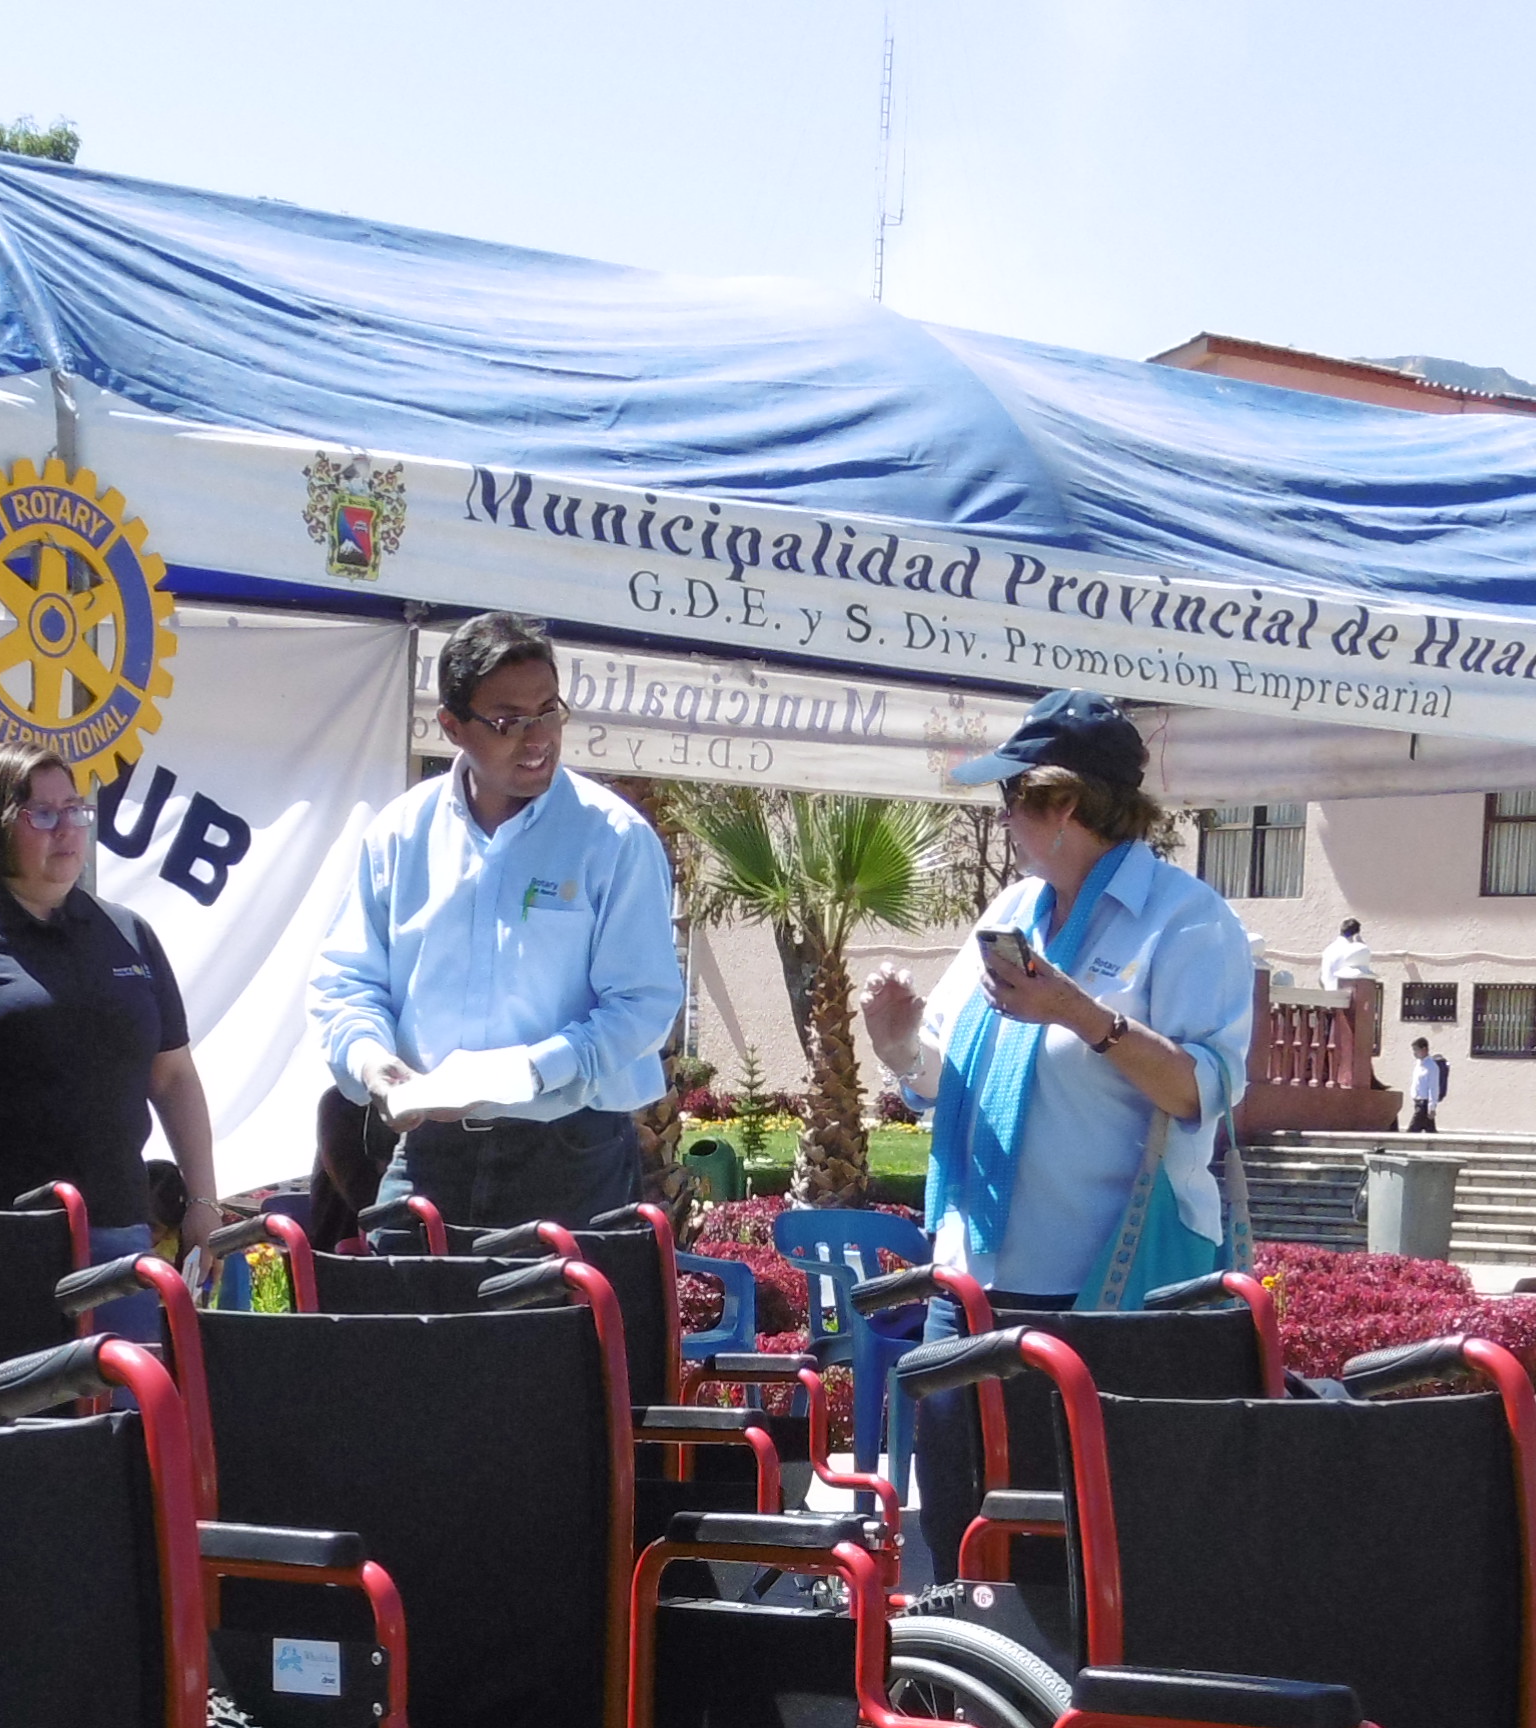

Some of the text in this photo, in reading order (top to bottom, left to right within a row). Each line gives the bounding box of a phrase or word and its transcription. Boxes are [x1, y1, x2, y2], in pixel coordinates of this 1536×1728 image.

[11, 490, 107, 540] ROTARY
[463, 465, 981, 599] Municipalidad
[1004, 553, 1320, 650] Provincial
[1331, 605, 1399, 661] de
[629, 570, 1453, 719] G.D.E. y S. Div. Promoción Empresarial
